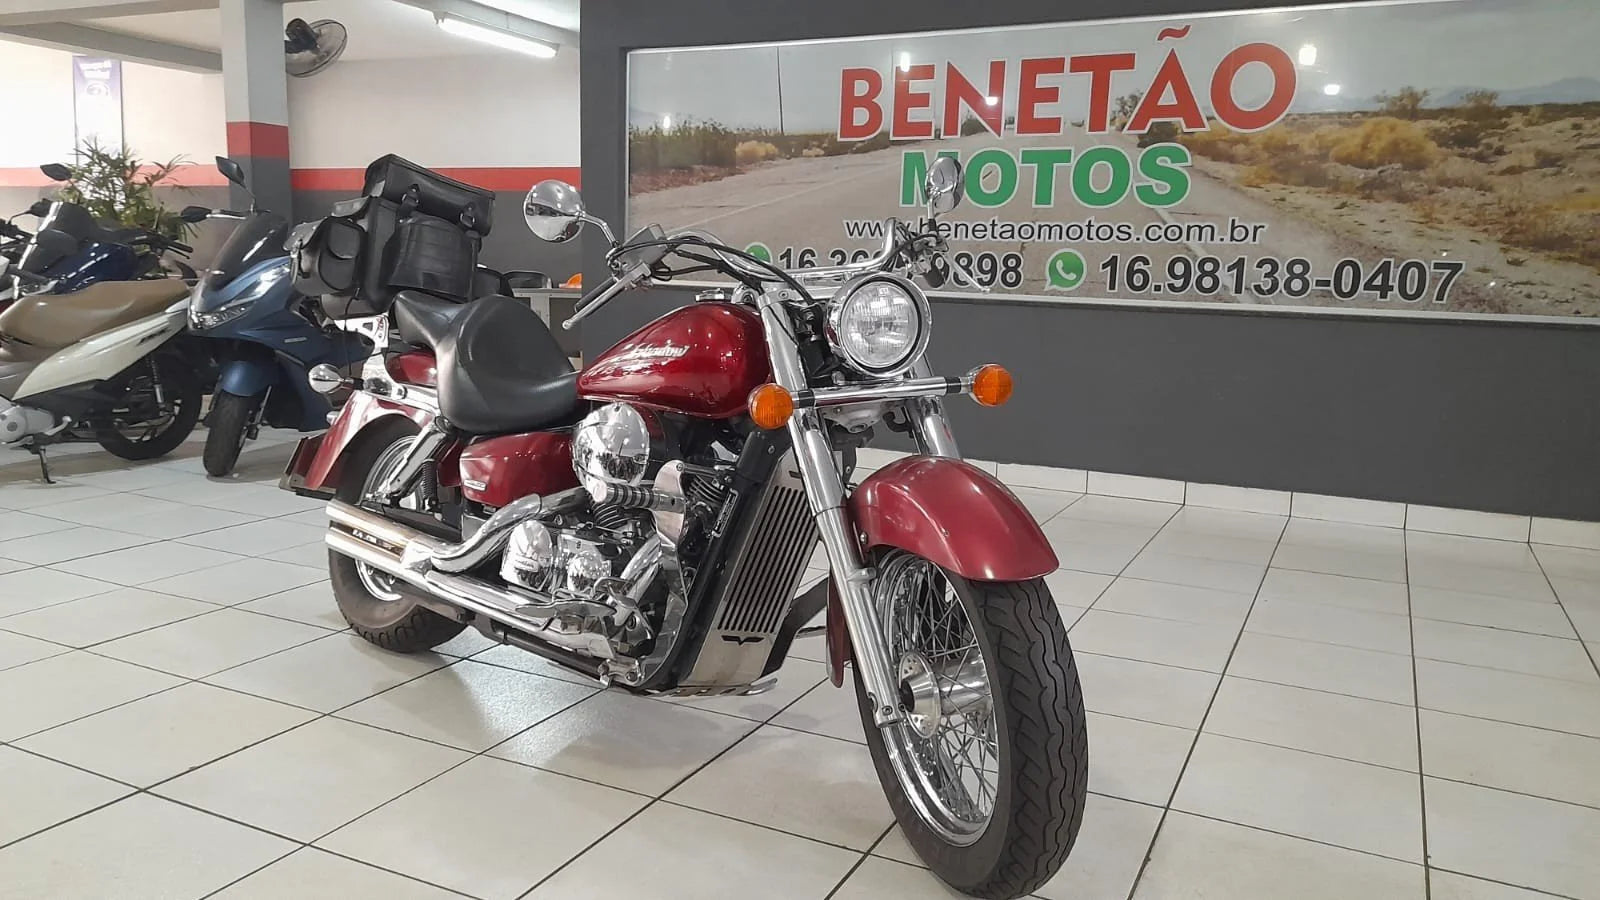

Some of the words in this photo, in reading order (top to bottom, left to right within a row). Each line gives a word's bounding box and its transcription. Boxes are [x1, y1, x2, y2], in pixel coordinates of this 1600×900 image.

[838, 24, 1297, 140] BENETÃO
[901, 143, 1192, 207] MOTOS
[846, 217, 1266, 243] wwenetaomotos.com.br
[778, 247, 1023, 288] 1639898
[1100, 254, 1465, 303] 16.98138-0407
